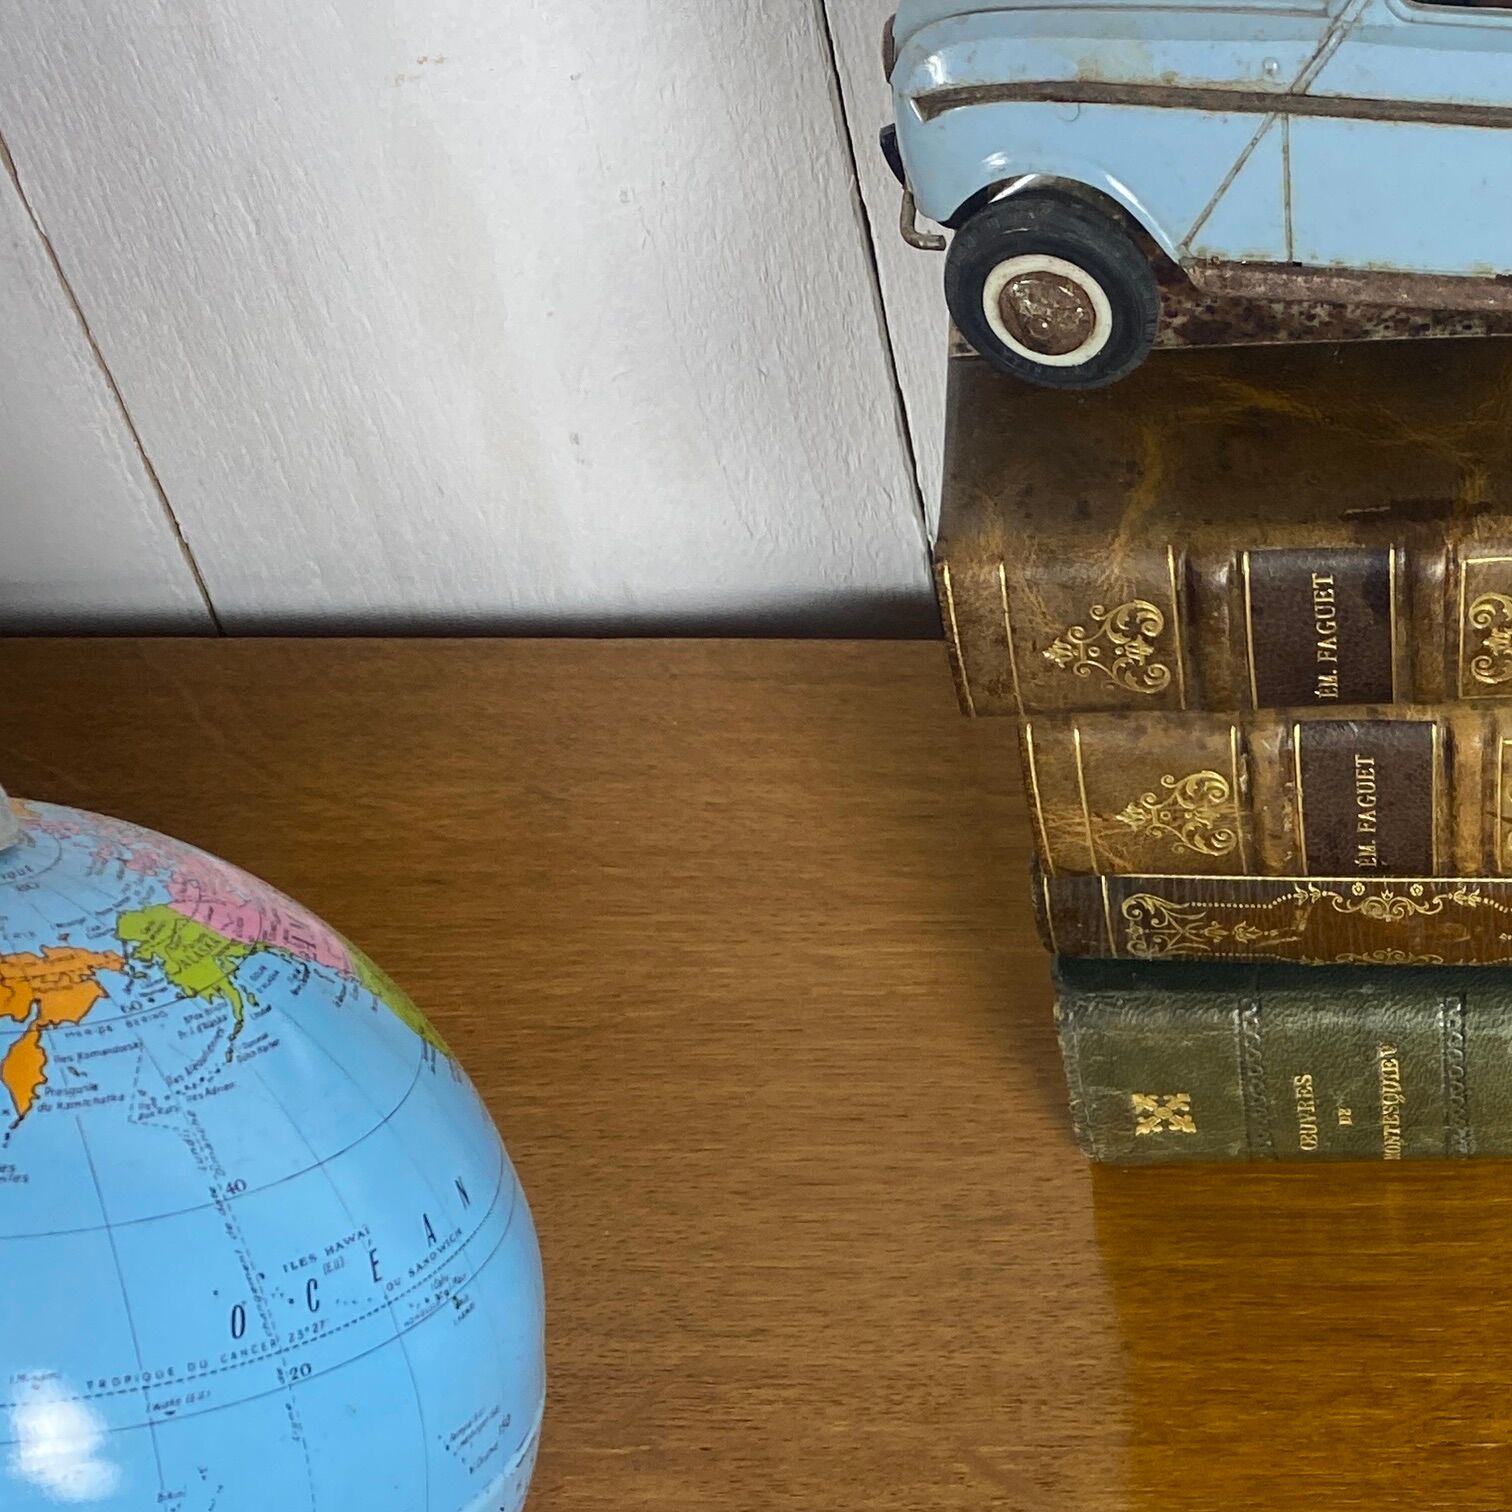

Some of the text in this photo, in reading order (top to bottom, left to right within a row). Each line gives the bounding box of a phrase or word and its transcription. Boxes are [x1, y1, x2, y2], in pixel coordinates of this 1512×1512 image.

[1311, 572, 1338, 663] FAGUET
[1354, 754, 1376, 832] FAGUET
[226, 1178, 247, 1194] 40
[86, 1367, 175, 1390] TROPIQUE
[187, 1360, 208, 1373] DU
[219, 1338, 277, 1364] CANCER
[289, 1363, 313, 1382] 20
